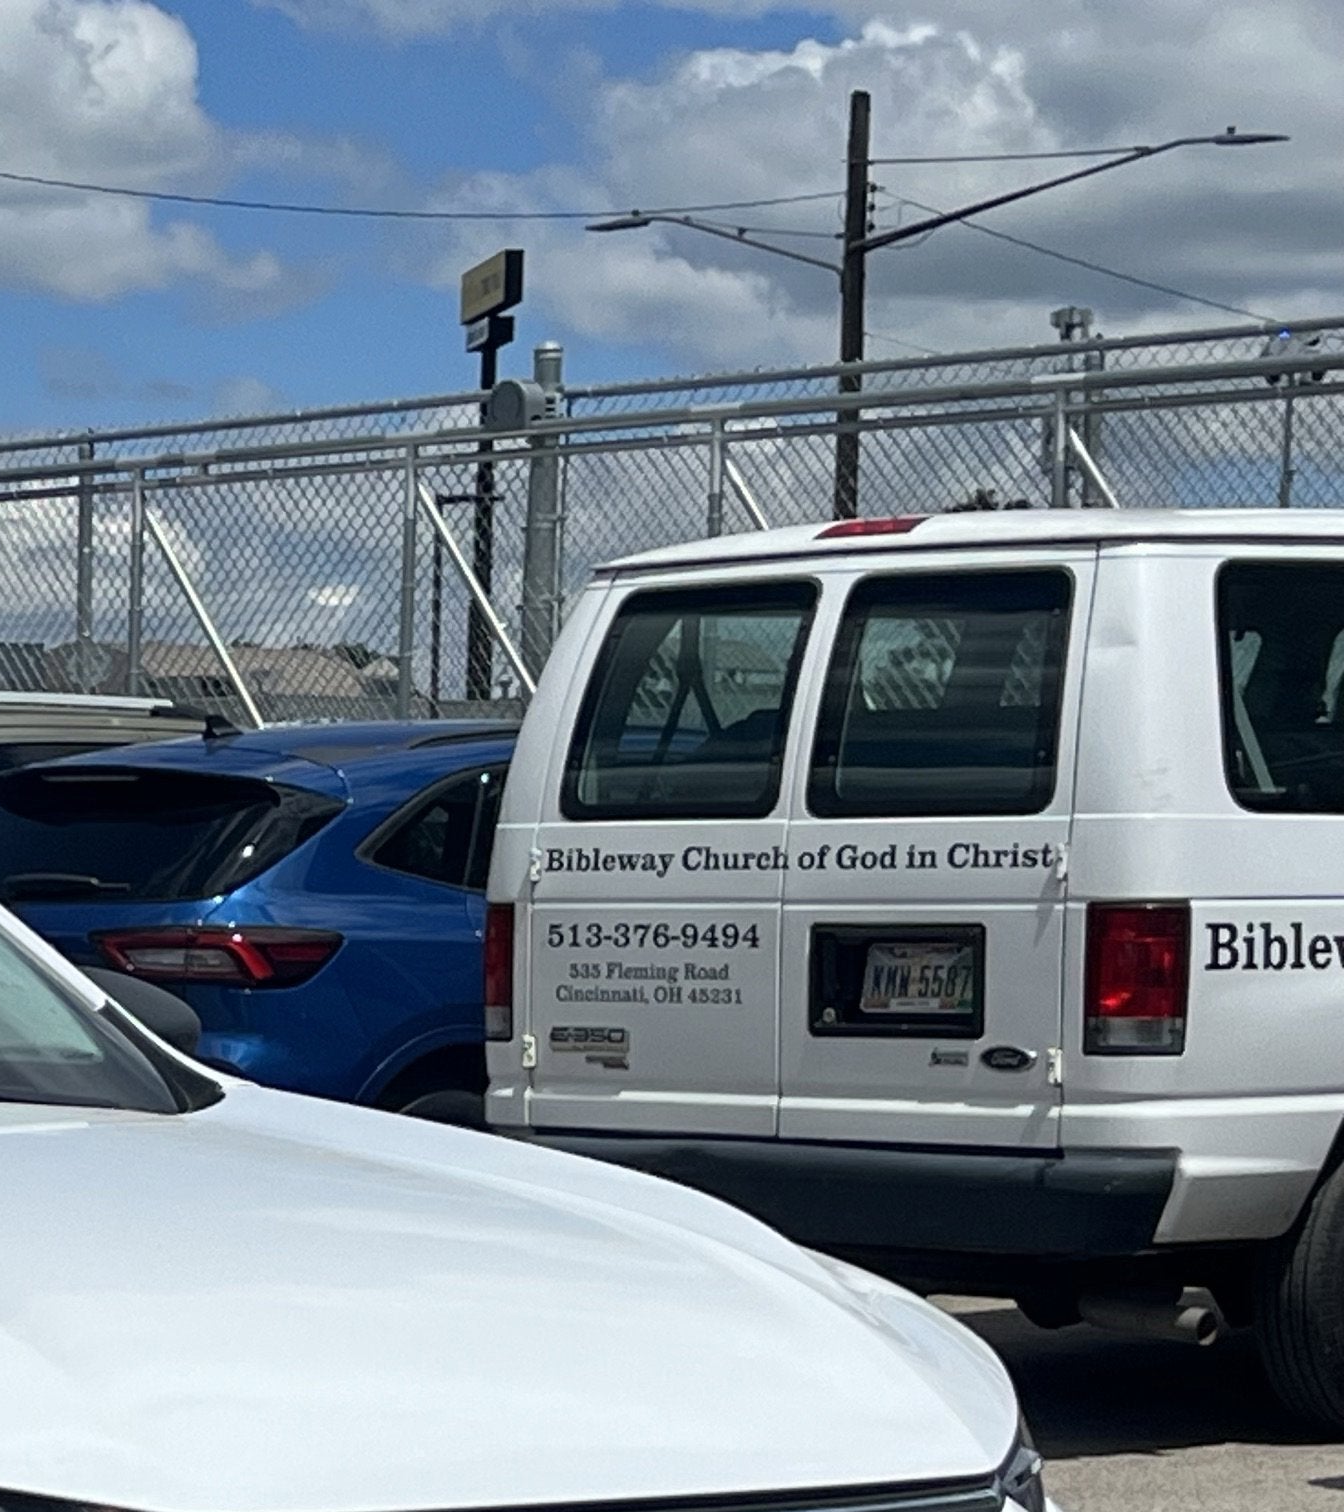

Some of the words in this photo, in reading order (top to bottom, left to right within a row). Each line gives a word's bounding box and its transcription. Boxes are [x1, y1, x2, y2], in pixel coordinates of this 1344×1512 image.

[545, 848, 674, 878] Bibleway
[682, 846, 789, 872] Church
[797, 844, 831, 870] of
[835, 844, 897, 870] God
[905, 844, 937, 869] in
[947, 842, 1054, 869] Christ
[547, 923, 760, 948] 513-376-9494
[569, 963, 601, 980] 535
[605, 962, 679, 983] Fleming
[684, 963, 730, 980] Road
[653, 986, 683, 1004] OH
[687, 988, 743, 1005] 45231
